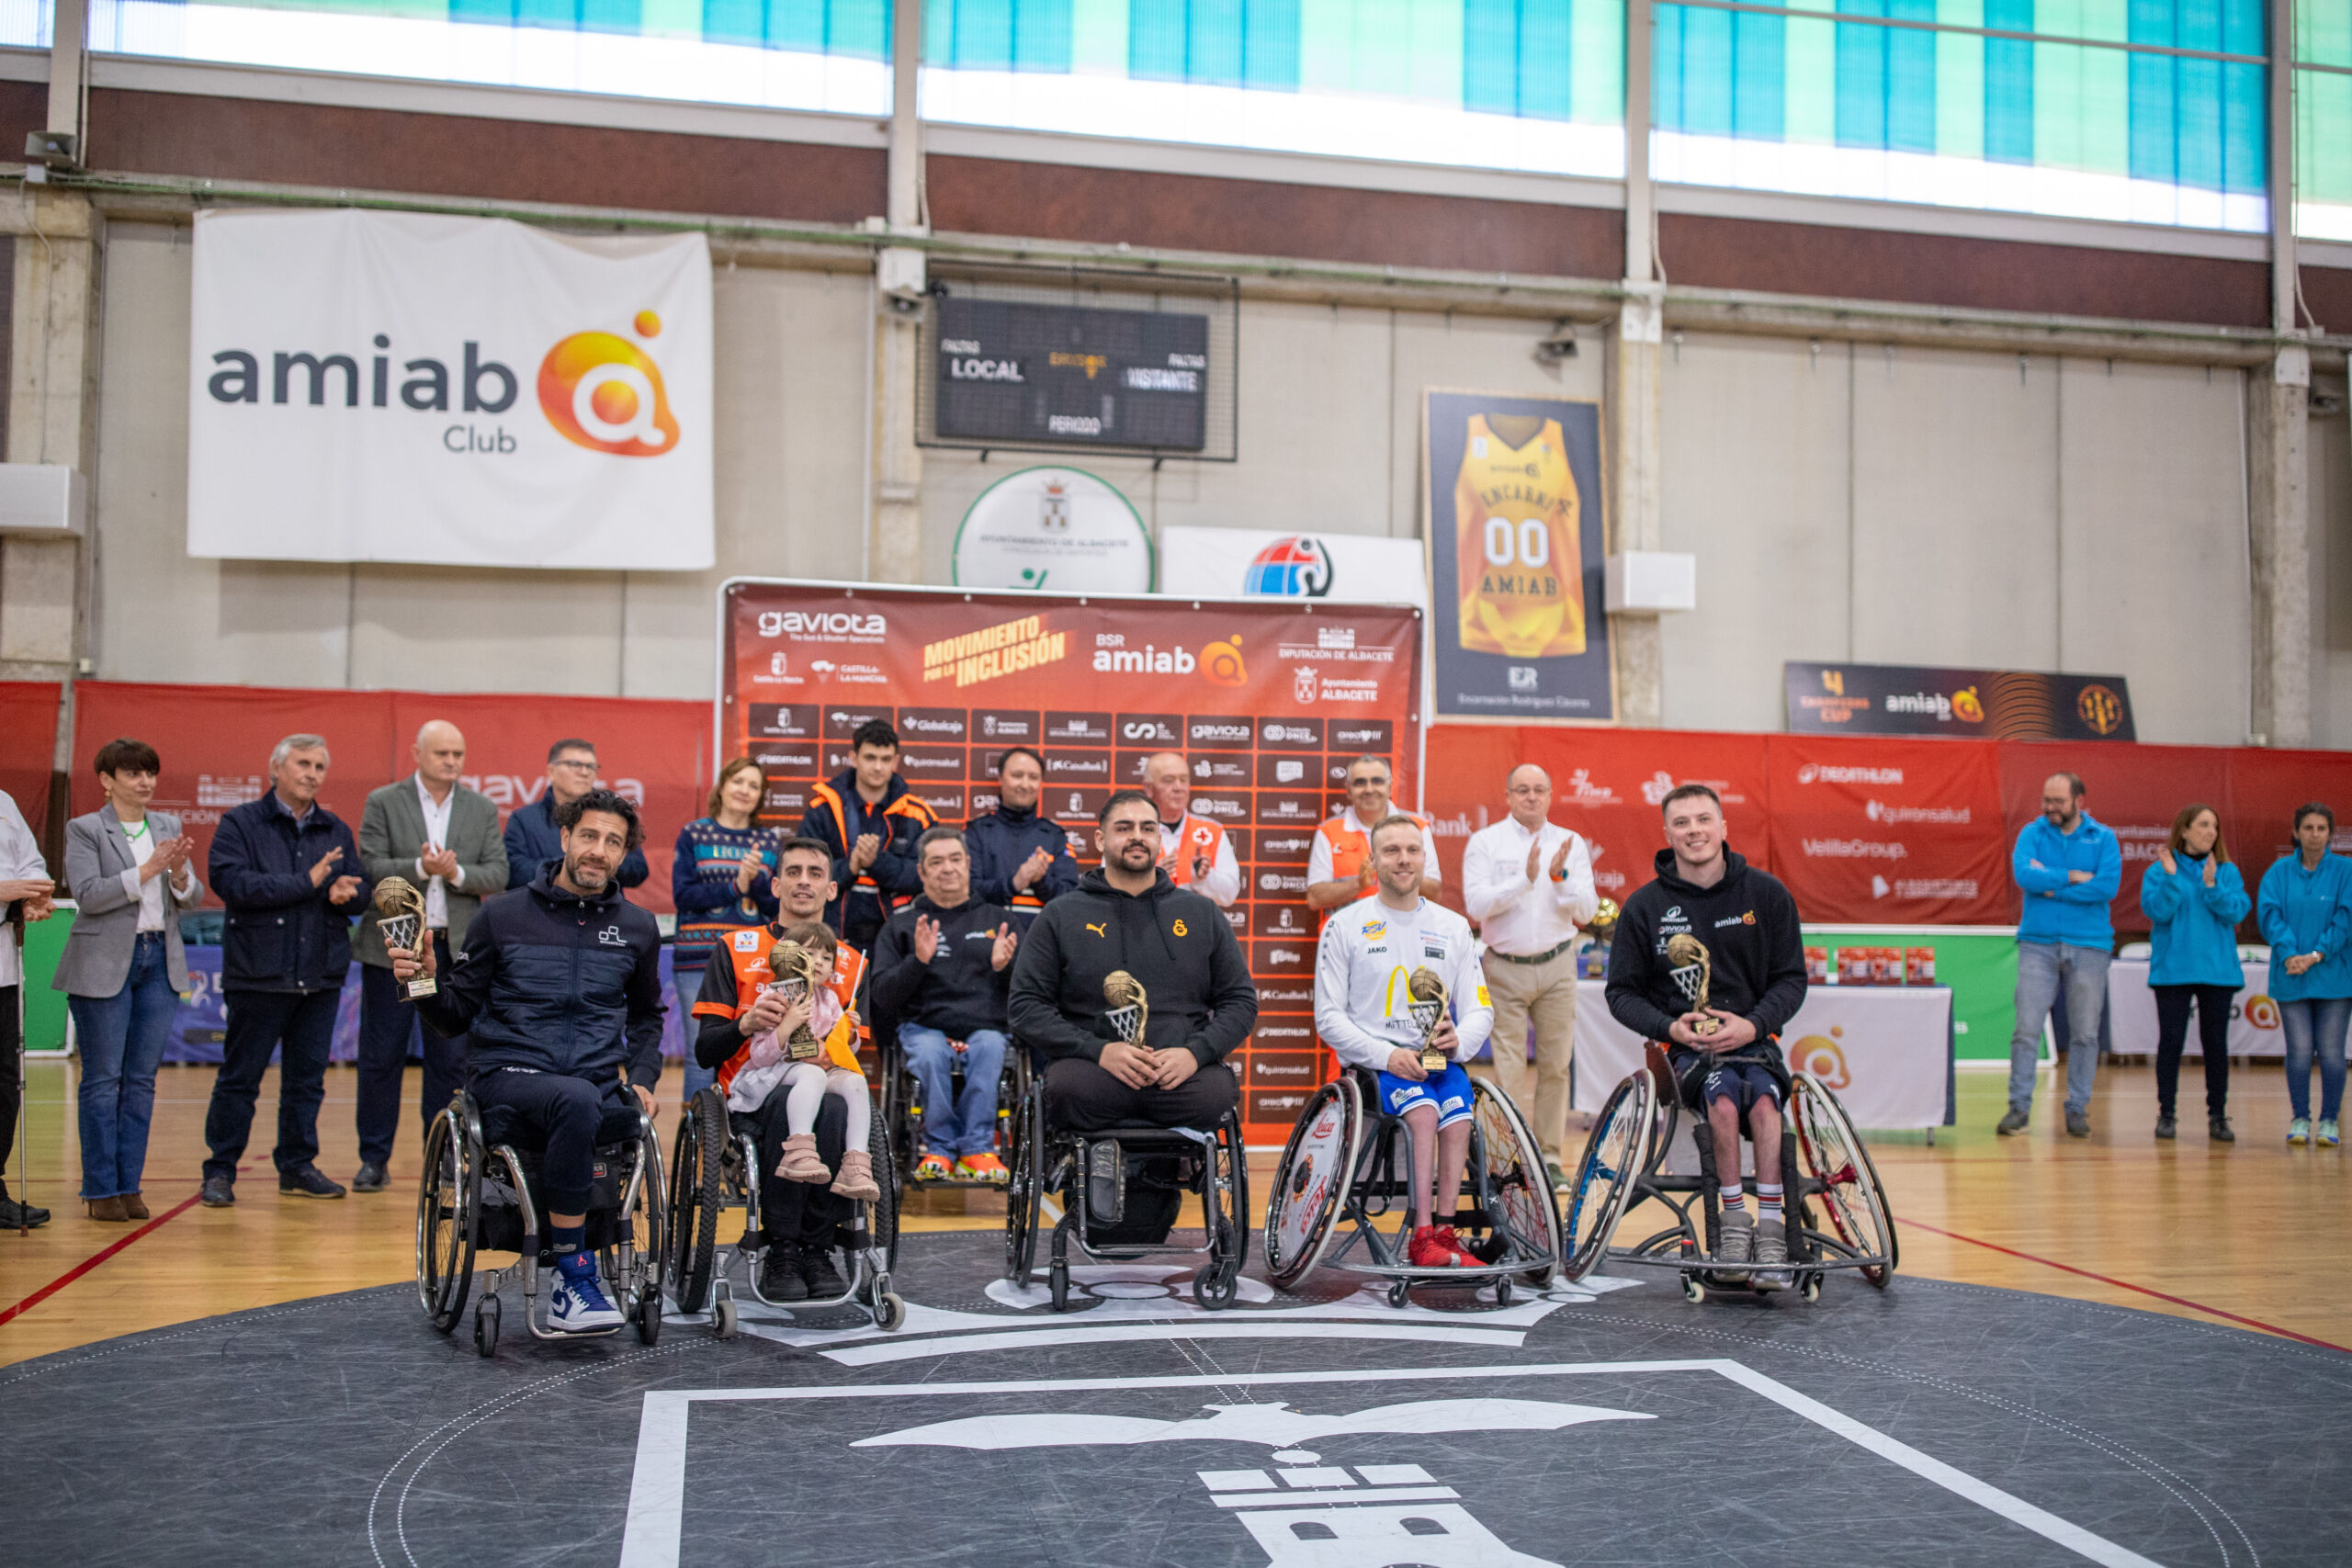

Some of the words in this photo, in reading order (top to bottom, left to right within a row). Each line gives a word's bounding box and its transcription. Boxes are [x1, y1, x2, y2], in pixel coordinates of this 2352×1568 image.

[208, 333, 518, 414] amiab
[951, 357, 1024, 382] LOCAL
[443, 425, 517, 454] Club
[1484, 516, 1549, 568] 00
[1482, 574, 1557, 596] AMIAB
[758, 611, 887, 638] gaviota
[924, 615, 1040, 669] MOVIMIENTO
[1096, 633, 1125, 647] BSR
[923, 666, 943, 682] POR
[944, 662, 956, 677] LA
[956, 629, 1065, 688] INCLUSIÓN
[1092, 644, 1196, 675] amiab
[1321, 689, 1378, 702] ALBACETE
[1886, 692, 1951, 713] amiab
[1819, 765, 1904, 784] DECATHLON
[1362, 921, 1387, 935] RSV
[1714, 916, 1742, 929] amiab
[1311, 1112, 1336, 1139] Leica
